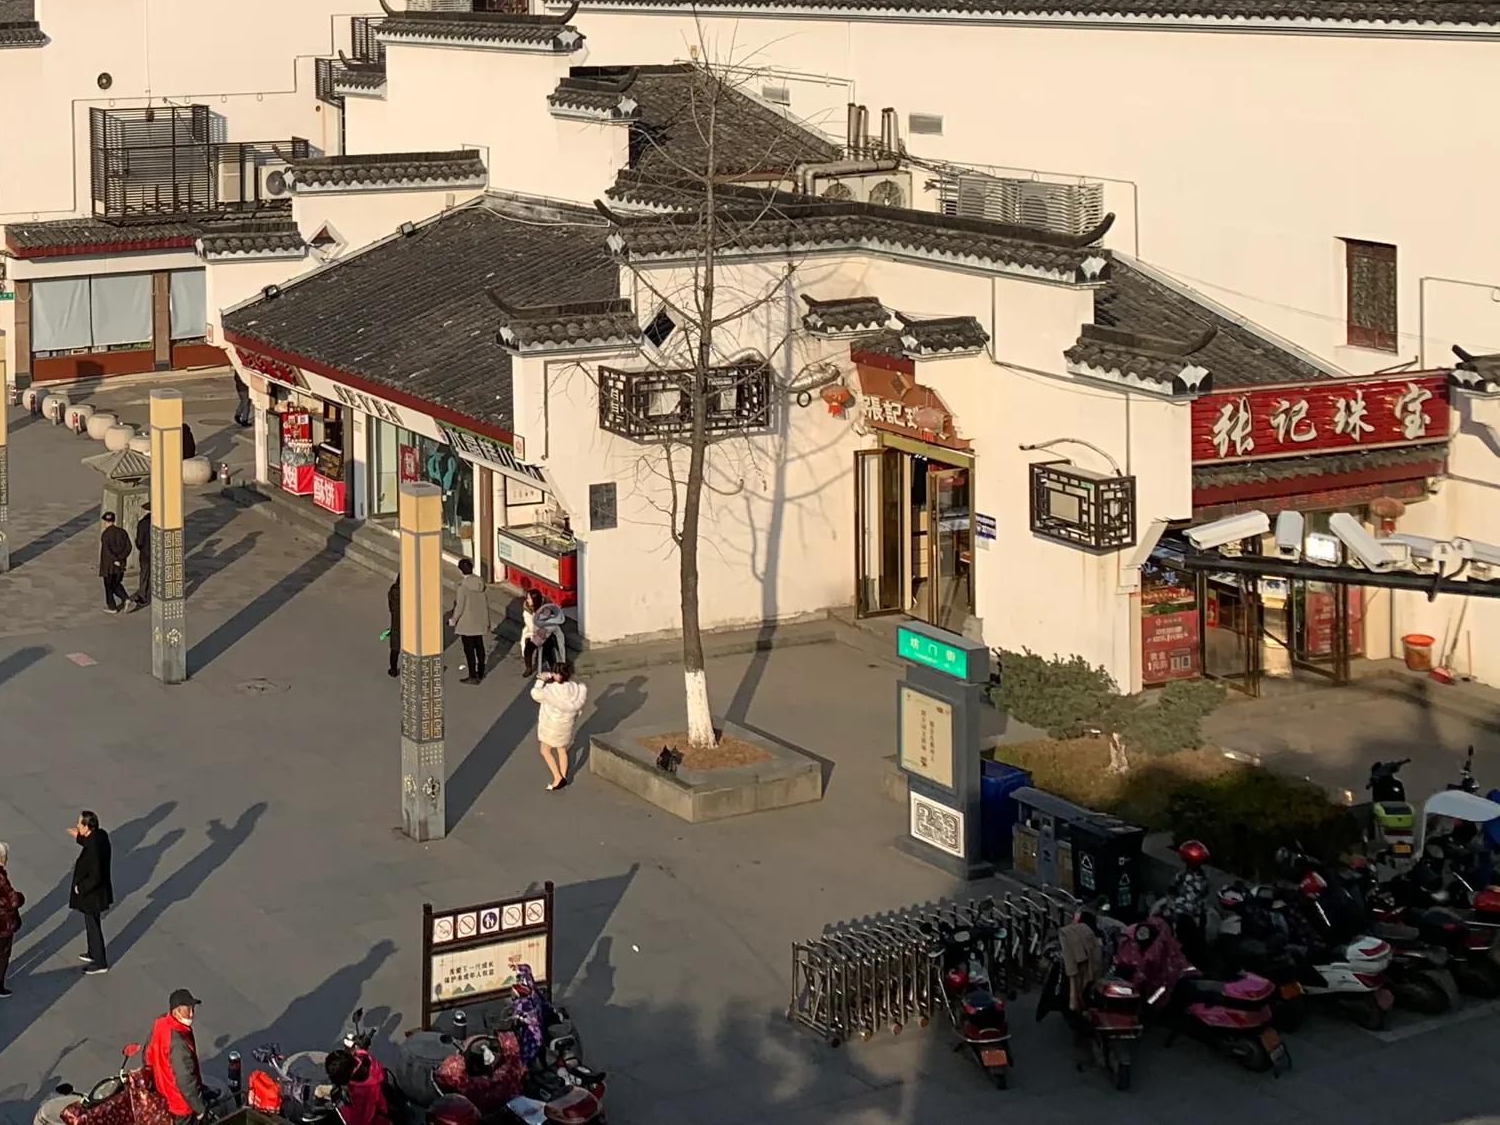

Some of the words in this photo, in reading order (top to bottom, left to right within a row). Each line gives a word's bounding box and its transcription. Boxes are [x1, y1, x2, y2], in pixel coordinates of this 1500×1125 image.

[332, 383, 405, 426] SEVEN
[1212, 383, 1433, 459] 张记珠宝
